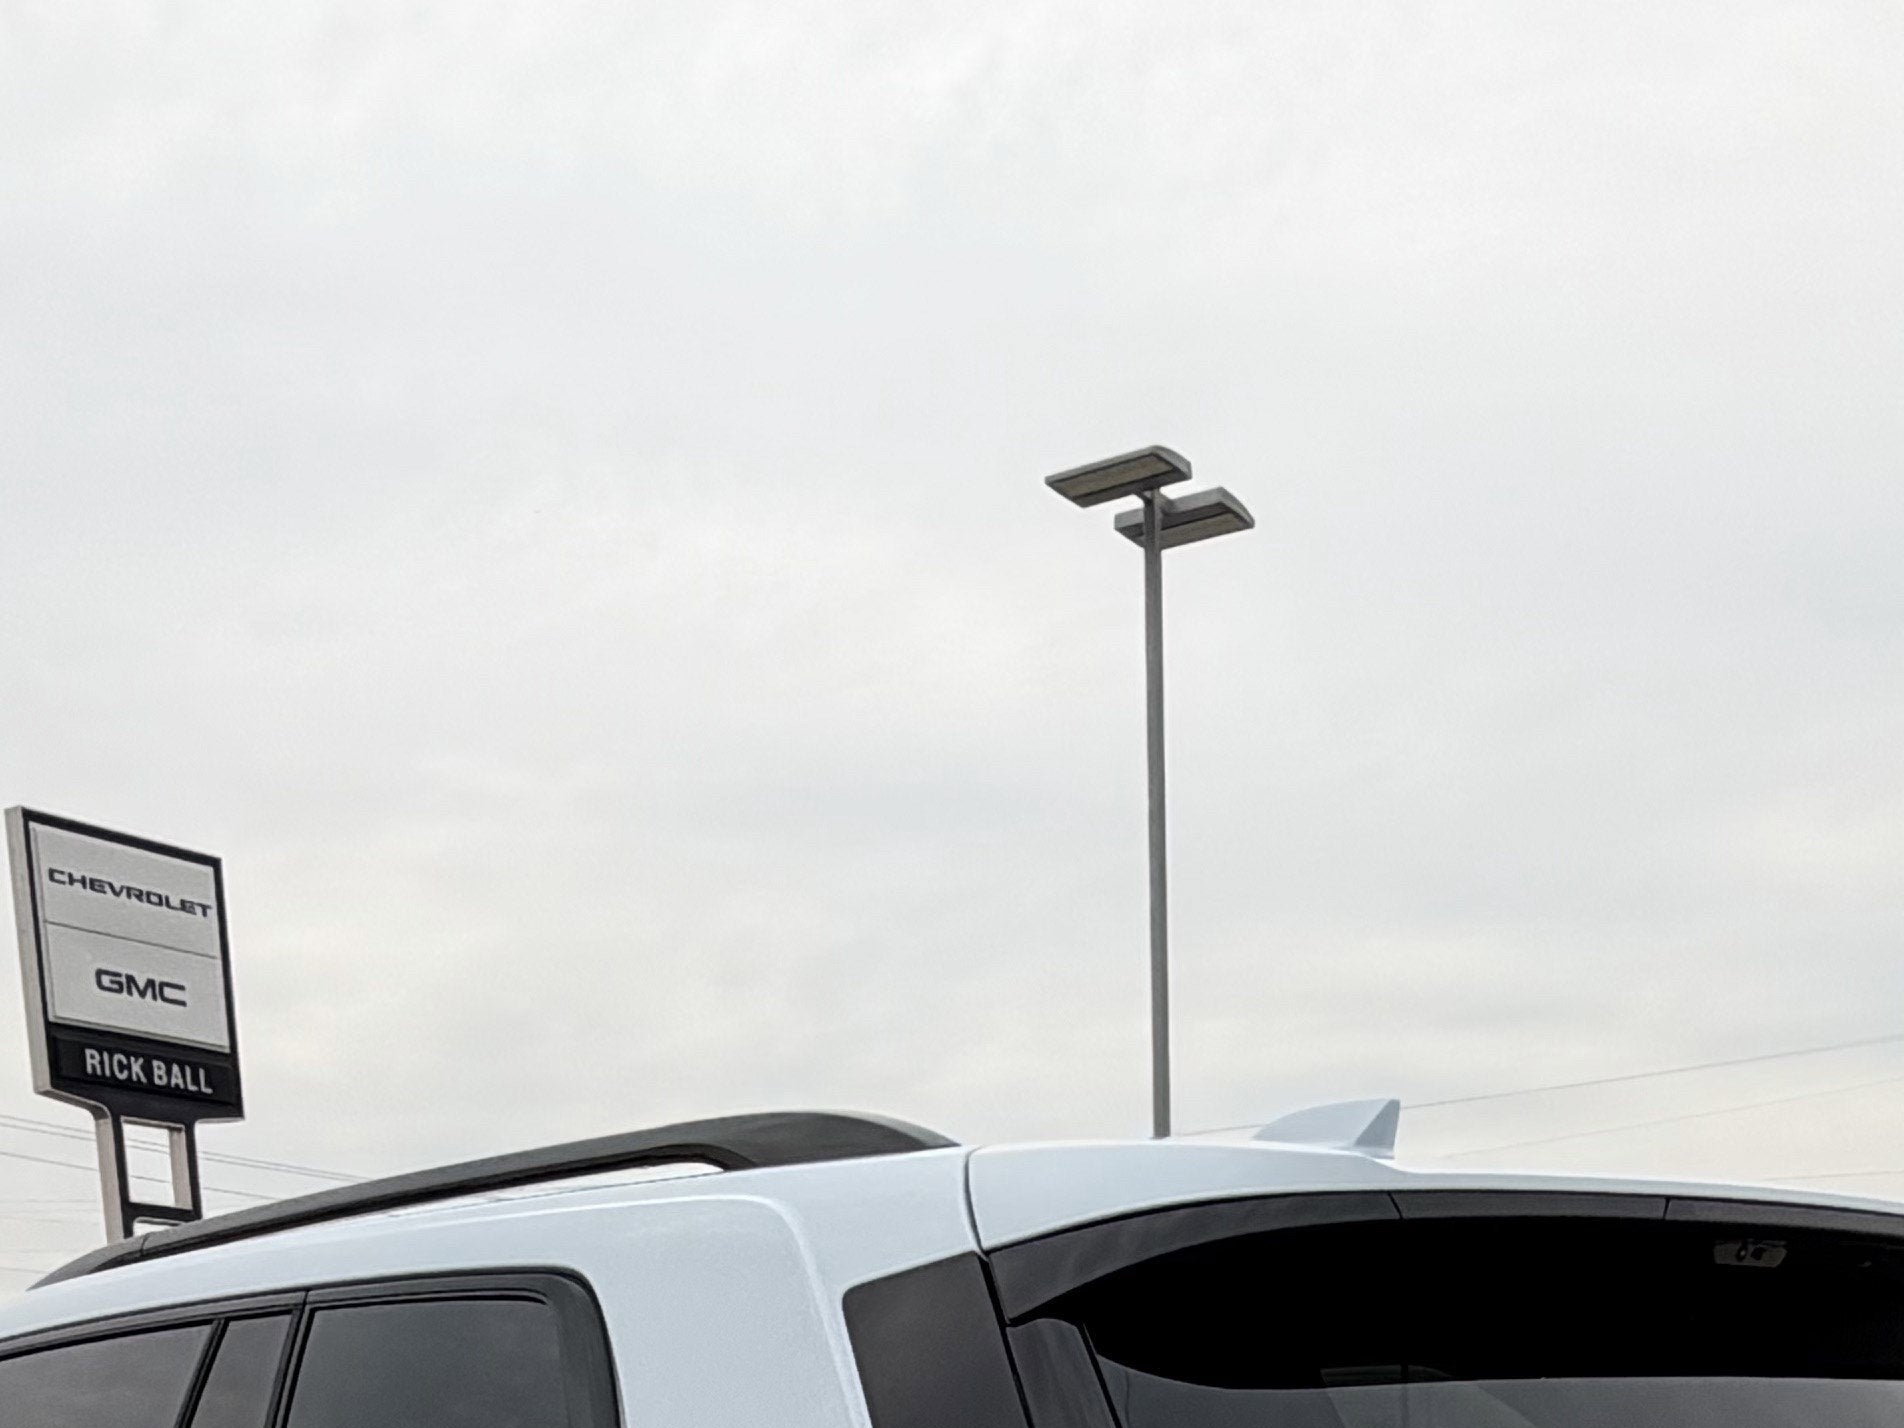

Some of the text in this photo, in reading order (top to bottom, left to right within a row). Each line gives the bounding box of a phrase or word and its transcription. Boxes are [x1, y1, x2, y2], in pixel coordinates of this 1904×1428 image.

[48, 867, 212, 918] CHEVROLET
[95, 967, 187, 1008] GMC
[84, 1047, 214, 1095] RICK BALL
